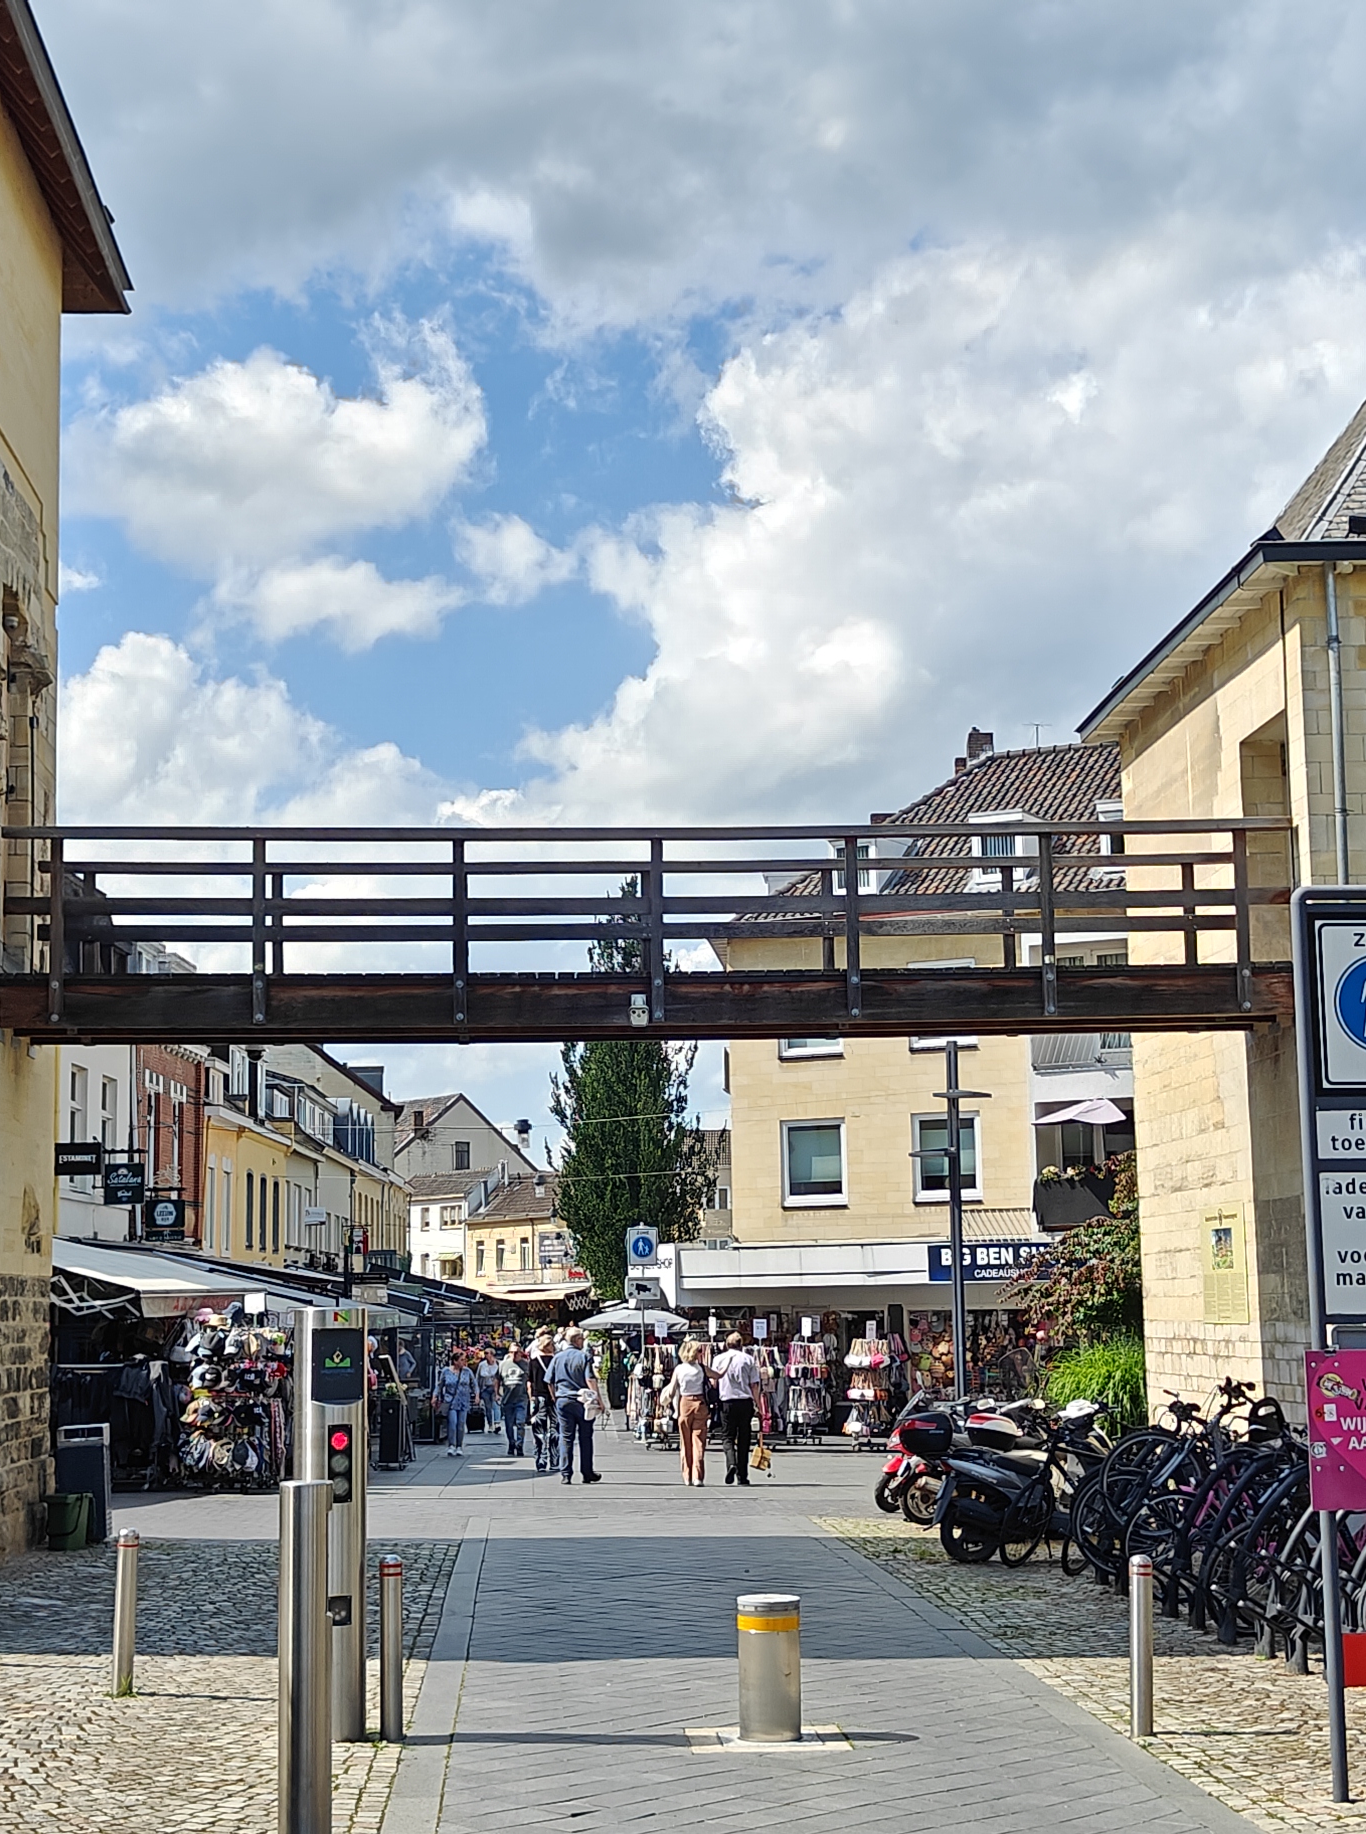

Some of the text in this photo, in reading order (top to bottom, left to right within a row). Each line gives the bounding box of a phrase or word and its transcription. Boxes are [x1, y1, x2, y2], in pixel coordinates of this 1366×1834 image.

[940, 1248, 972, 1266] BG
[976, 1247, 1013, 1265] BEN
[1340, 1416, 1366, 1434] WIJ
